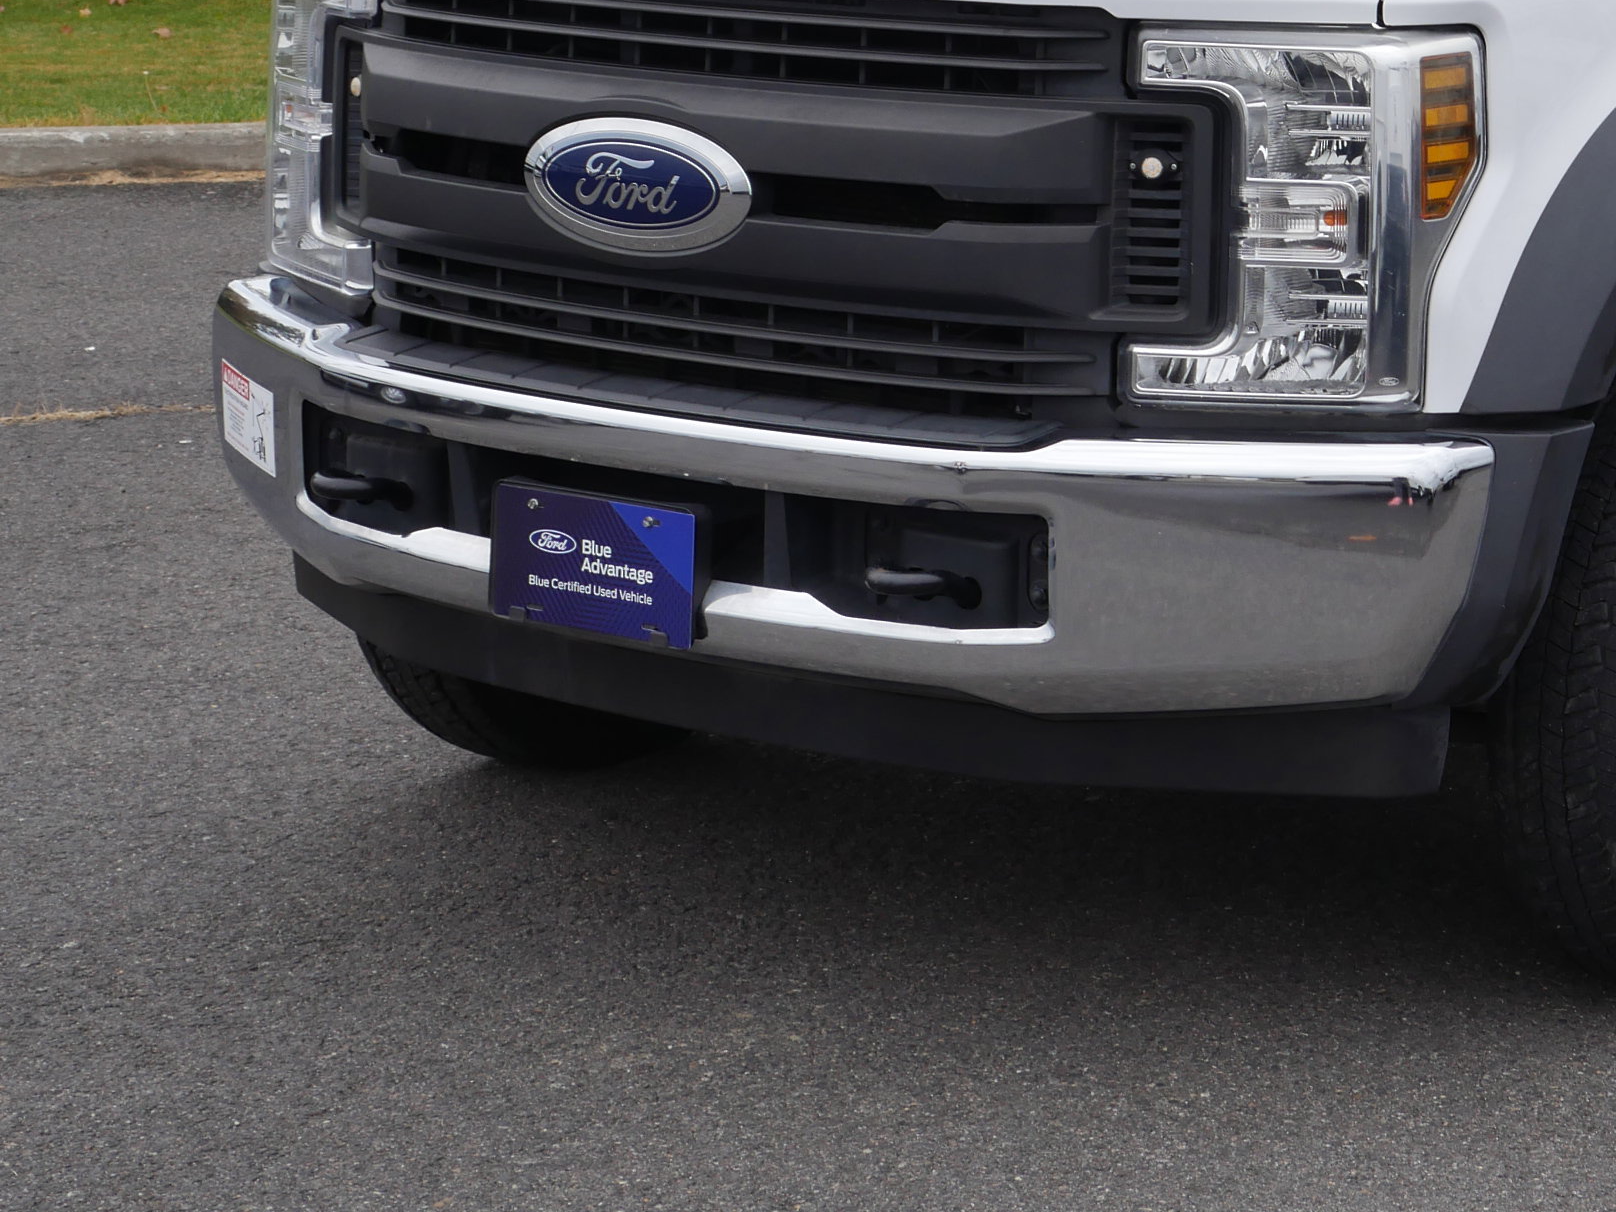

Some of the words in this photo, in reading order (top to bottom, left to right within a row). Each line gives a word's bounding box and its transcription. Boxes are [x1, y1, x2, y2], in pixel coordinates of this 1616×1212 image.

[575, 151, 681, 215] Ford
[537, 531, 568, 551] Ford
[581, 539, 612, 558] Blue
[581, 557, 653, 585] Advantage
[528, 574, 550, 588] Blue
[551, 578, 592, 595] Certified
[593, 585, 618, 599] Used
[619, 589, 653, 605] Vehicle
